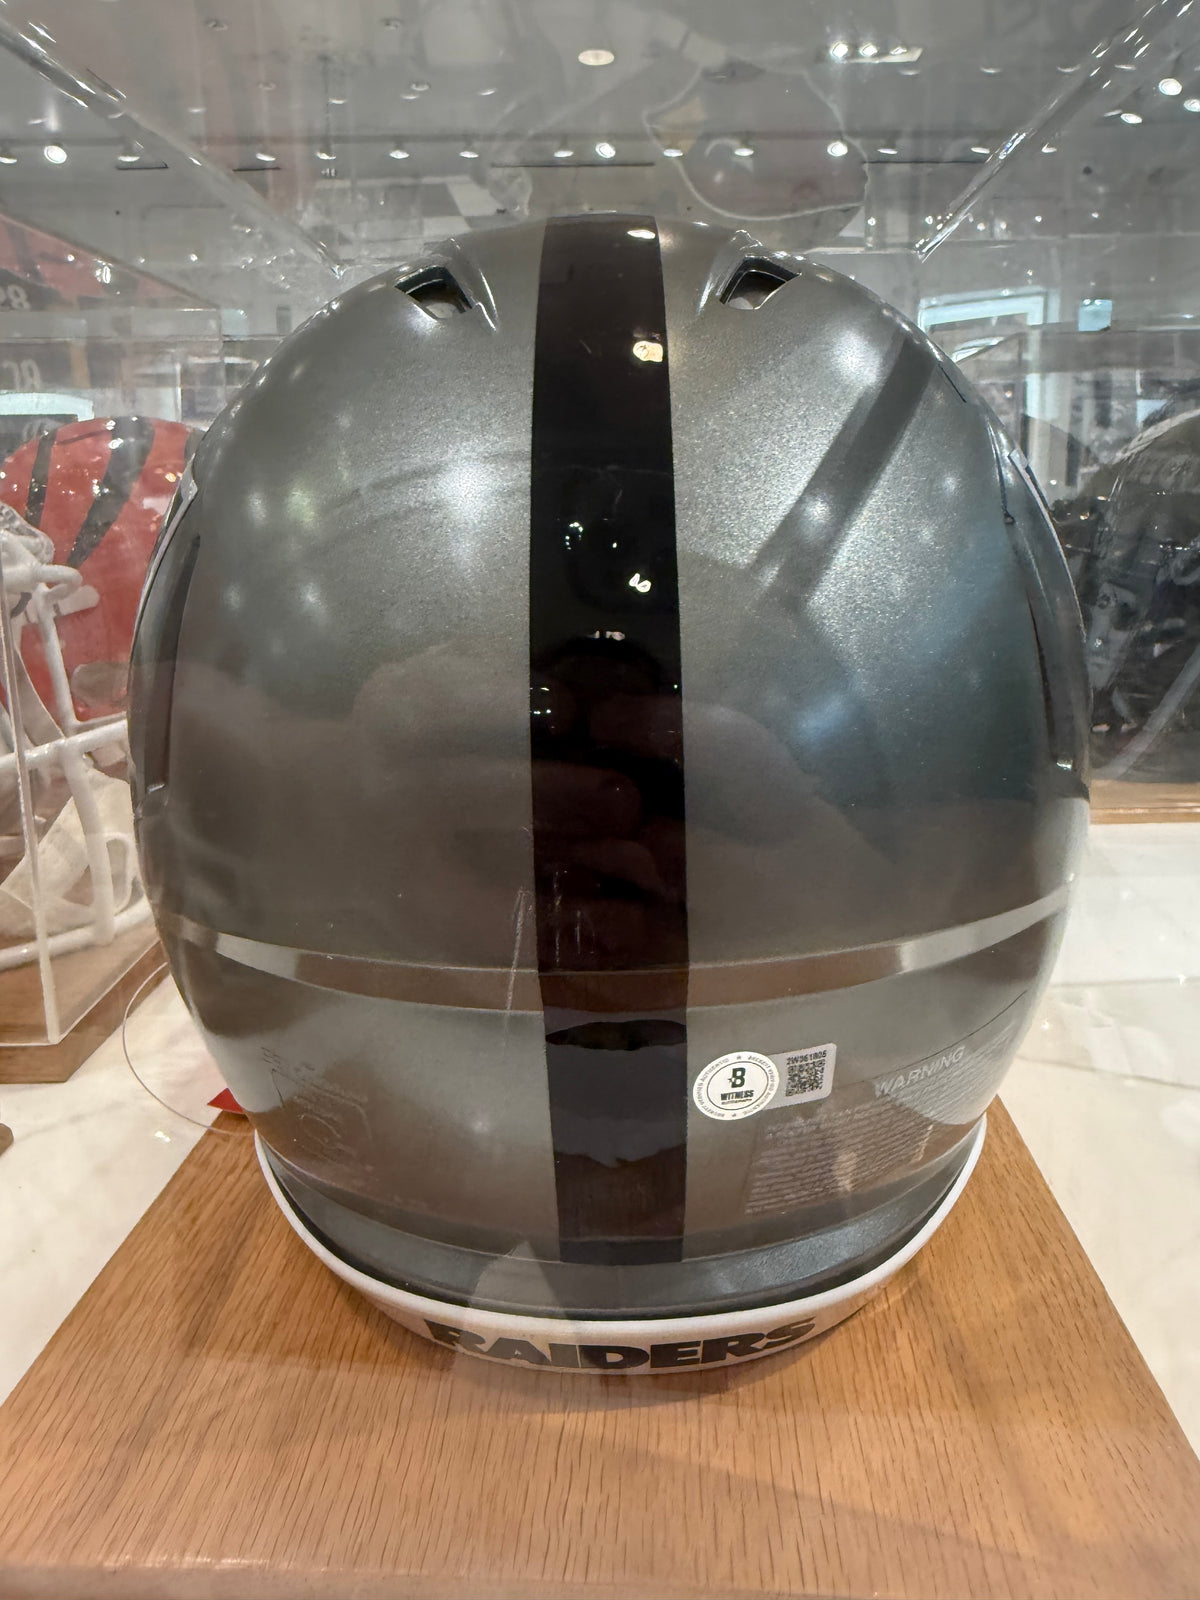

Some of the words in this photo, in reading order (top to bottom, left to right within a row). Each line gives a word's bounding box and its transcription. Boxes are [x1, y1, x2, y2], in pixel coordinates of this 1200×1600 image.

[720, 1089, 755, 1101] WITNESS
[873, 1045, 966, 1098] WARNING
[423, 1316, 816, 1369] RAIDERS
